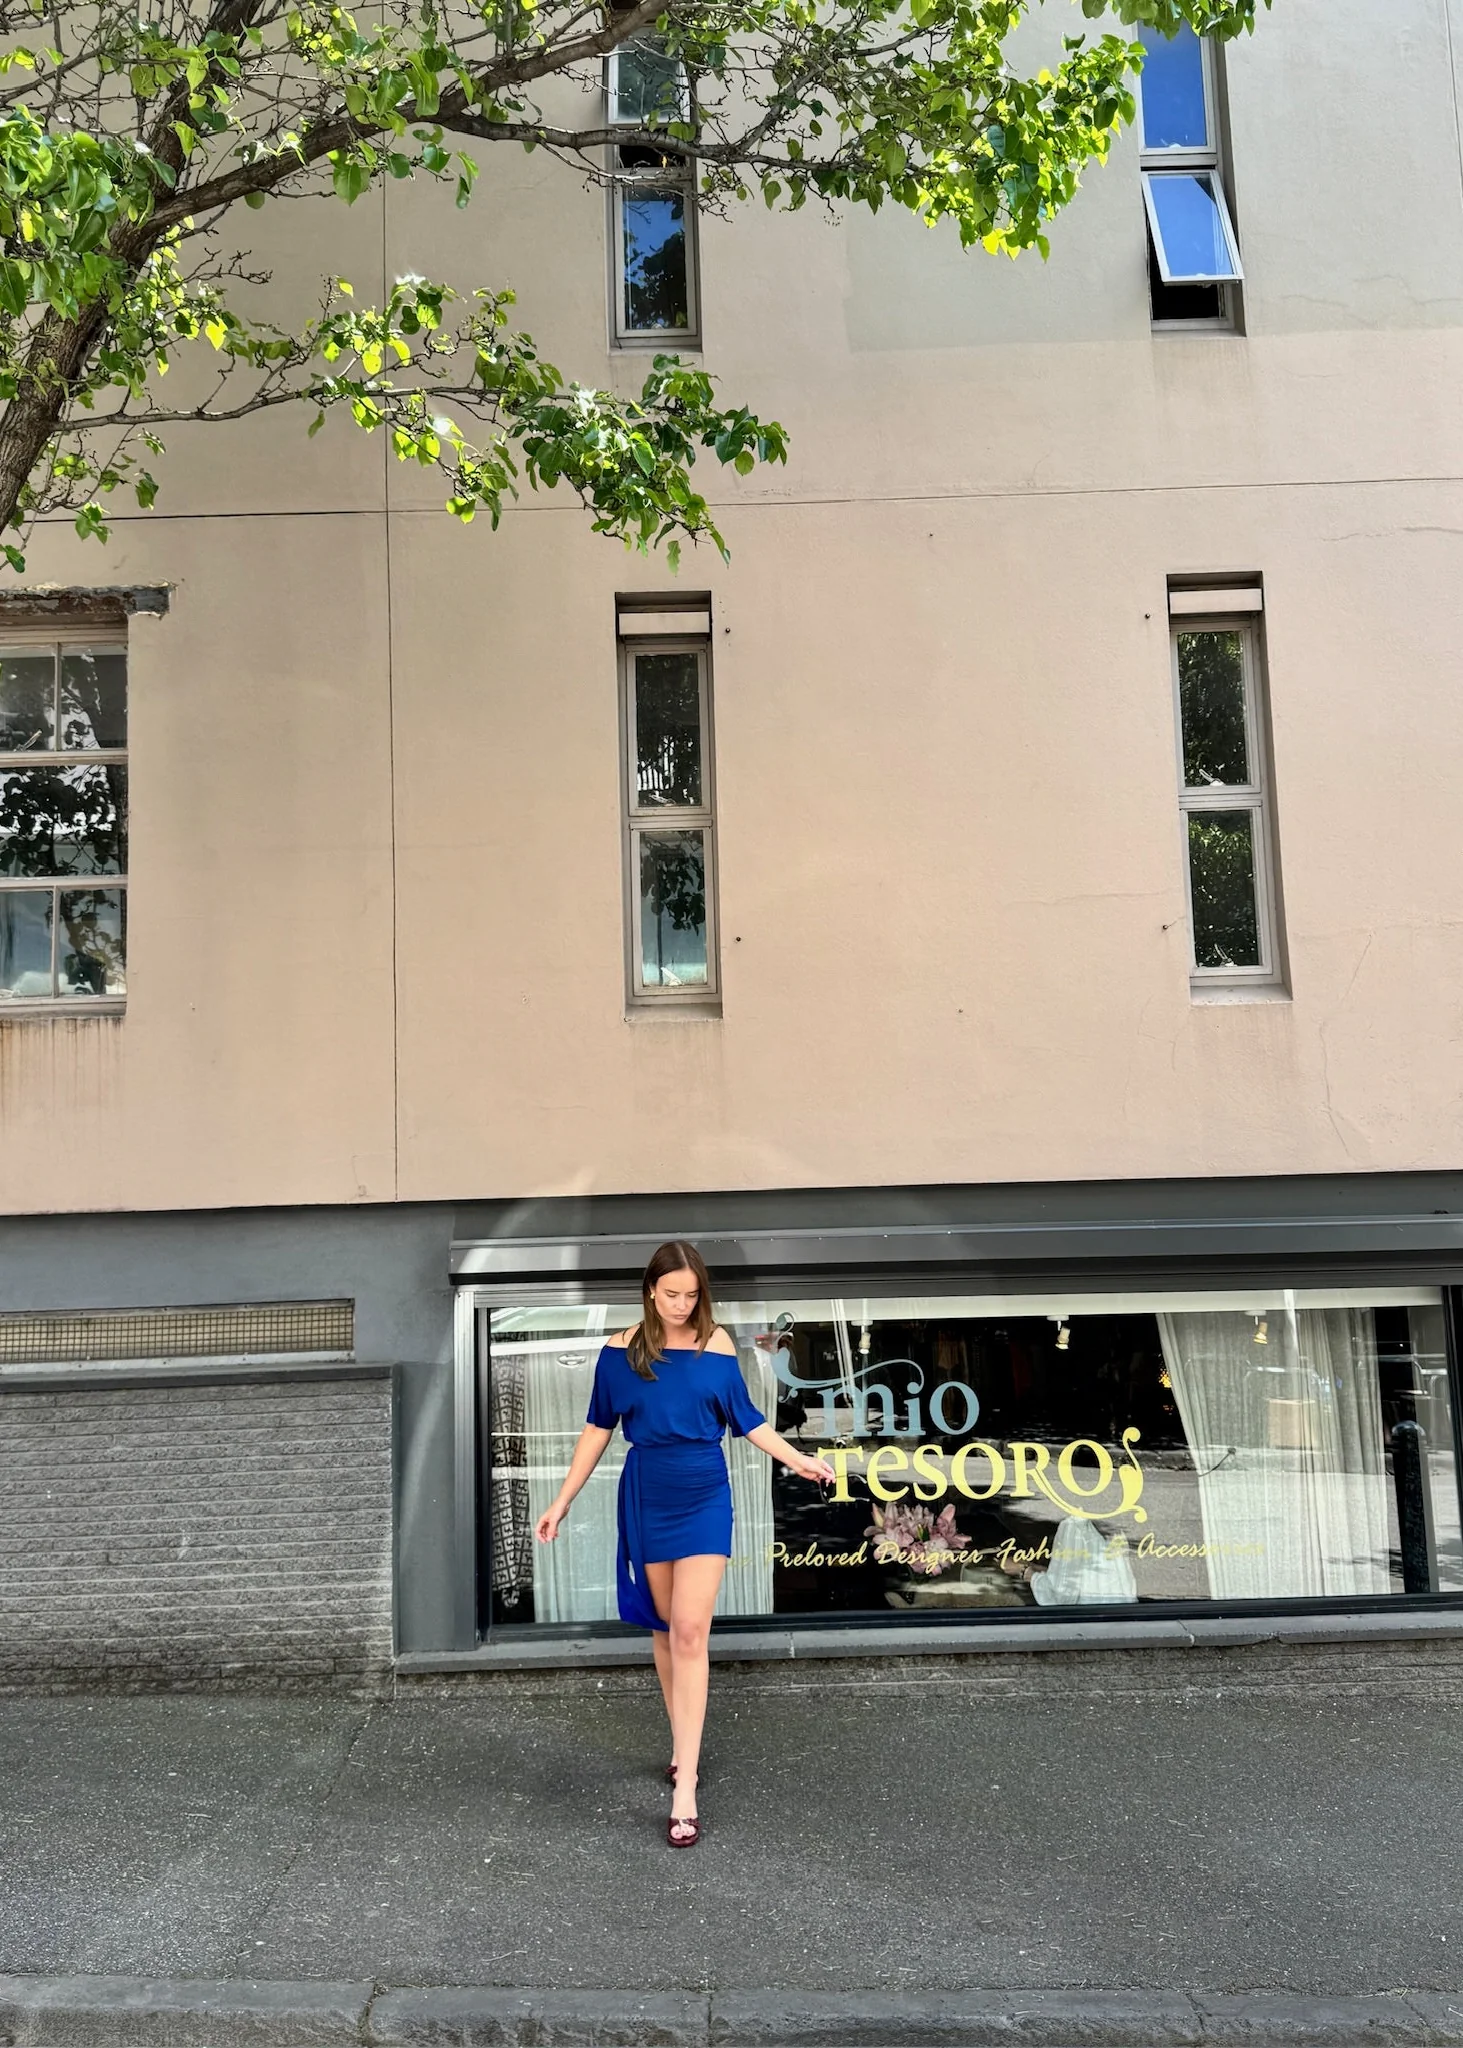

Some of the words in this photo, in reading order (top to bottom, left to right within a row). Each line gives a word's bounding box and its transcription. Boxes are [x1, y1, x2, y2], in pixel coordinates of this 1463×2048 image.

[808, 1359, 980, 1438] mio
[763, 1540, 868, 1571] Preloved
[874, 1540, 983, 1575] Designer
[1136, 1532, 1265, 1559] Access
